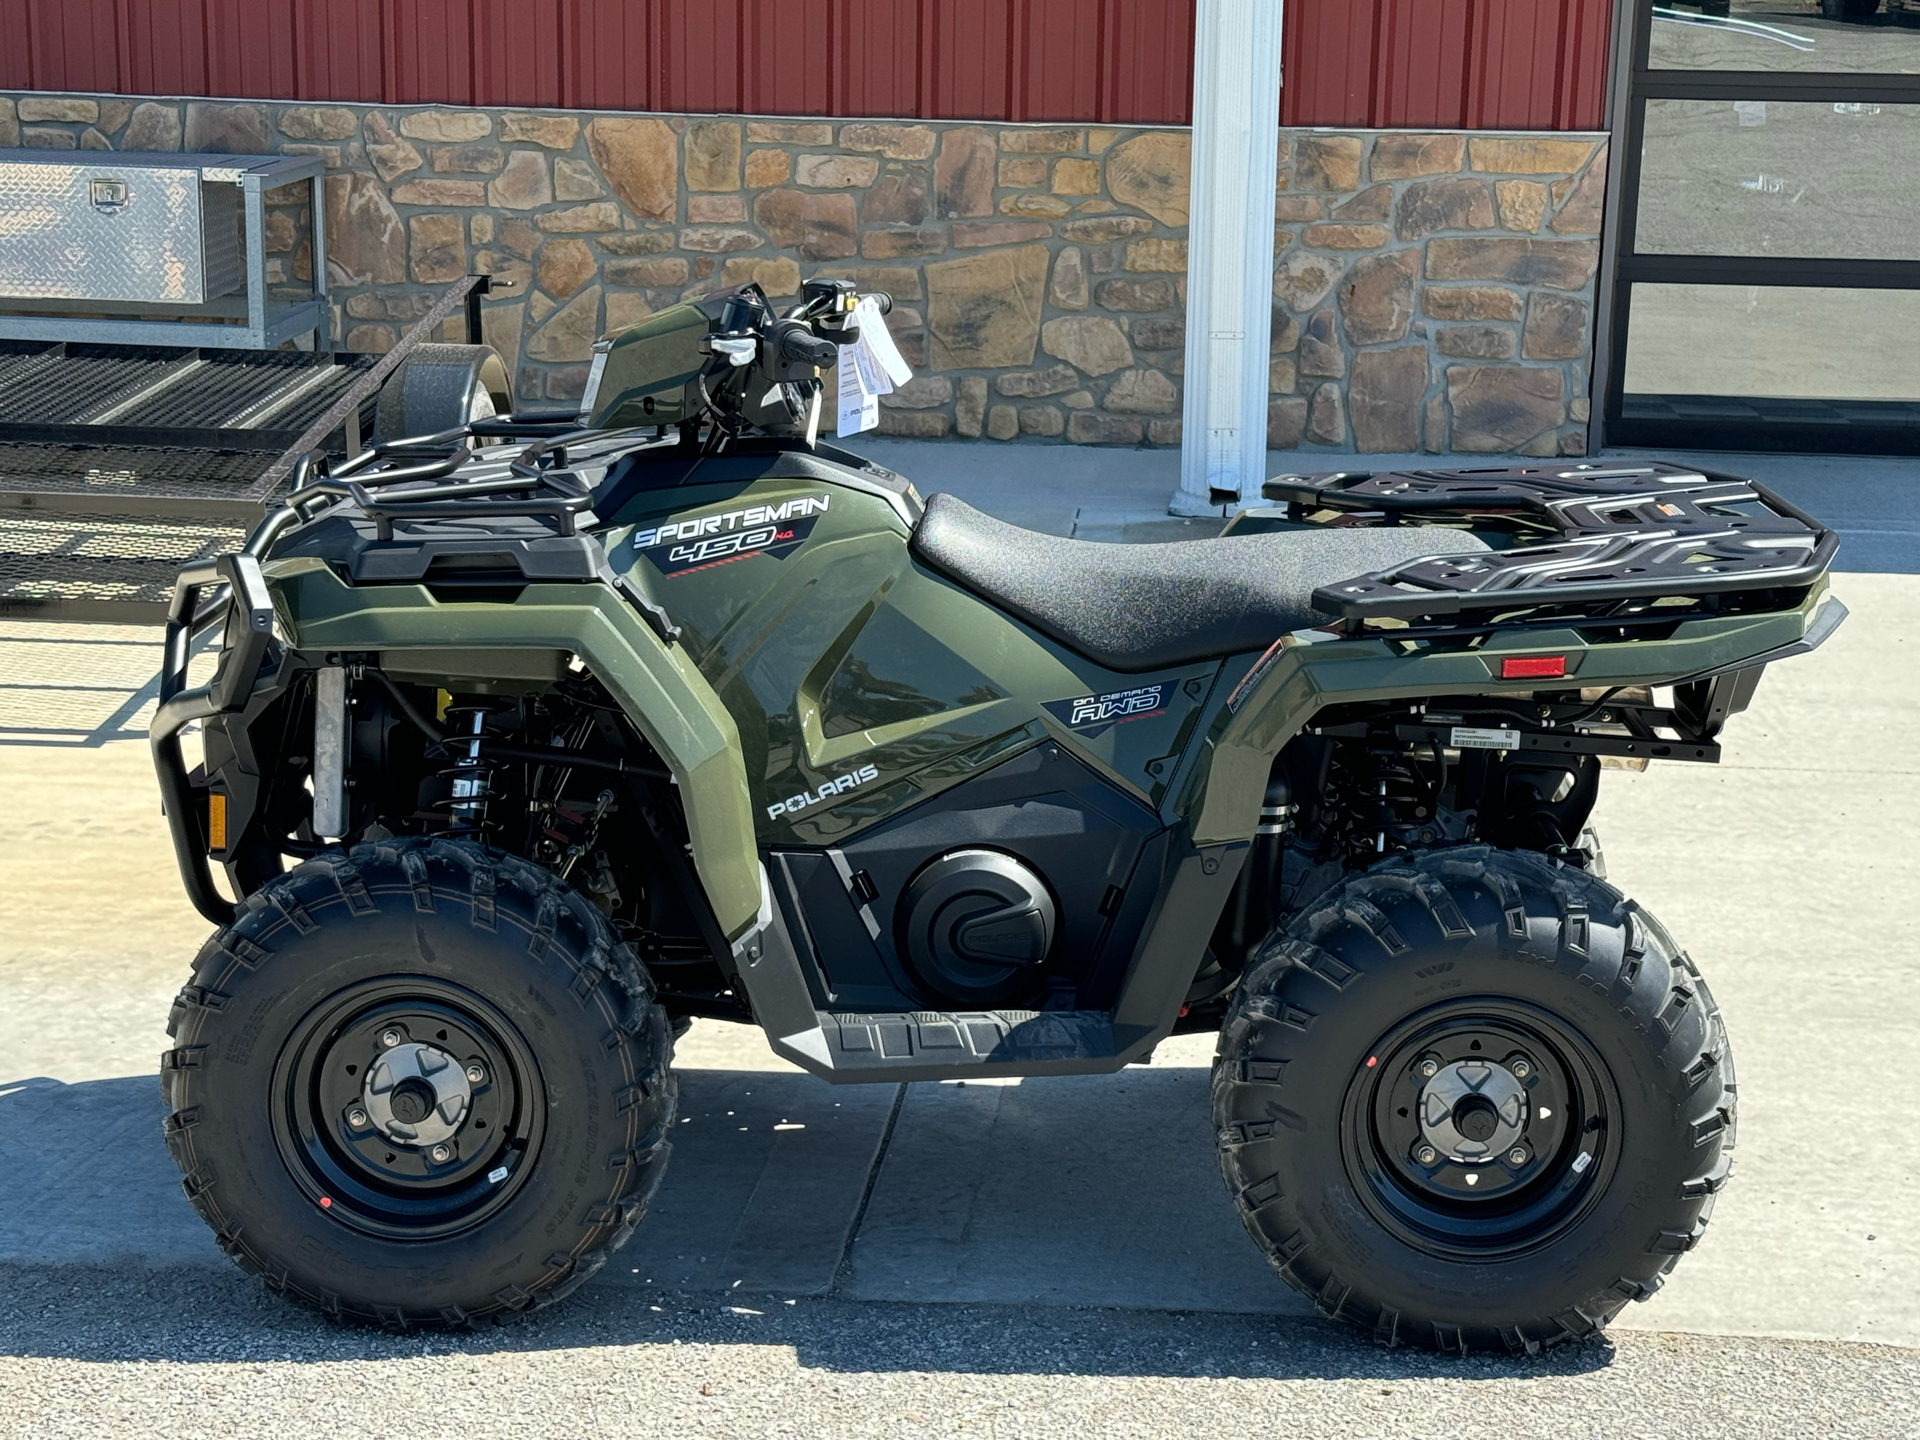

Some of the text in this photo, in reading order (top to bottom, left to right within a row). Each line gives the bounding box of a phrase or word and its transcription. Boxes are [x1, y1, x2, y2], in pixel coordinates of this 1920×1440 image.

[633, 492, 832, 549] SPORTSMAN
[668, 526, 777, 563] 450
[1071, 692, 1160, 725] AWD
[1073, 685, 1161, 706] ON DEMAND
[767, 763, 879, 821] POLARIS
